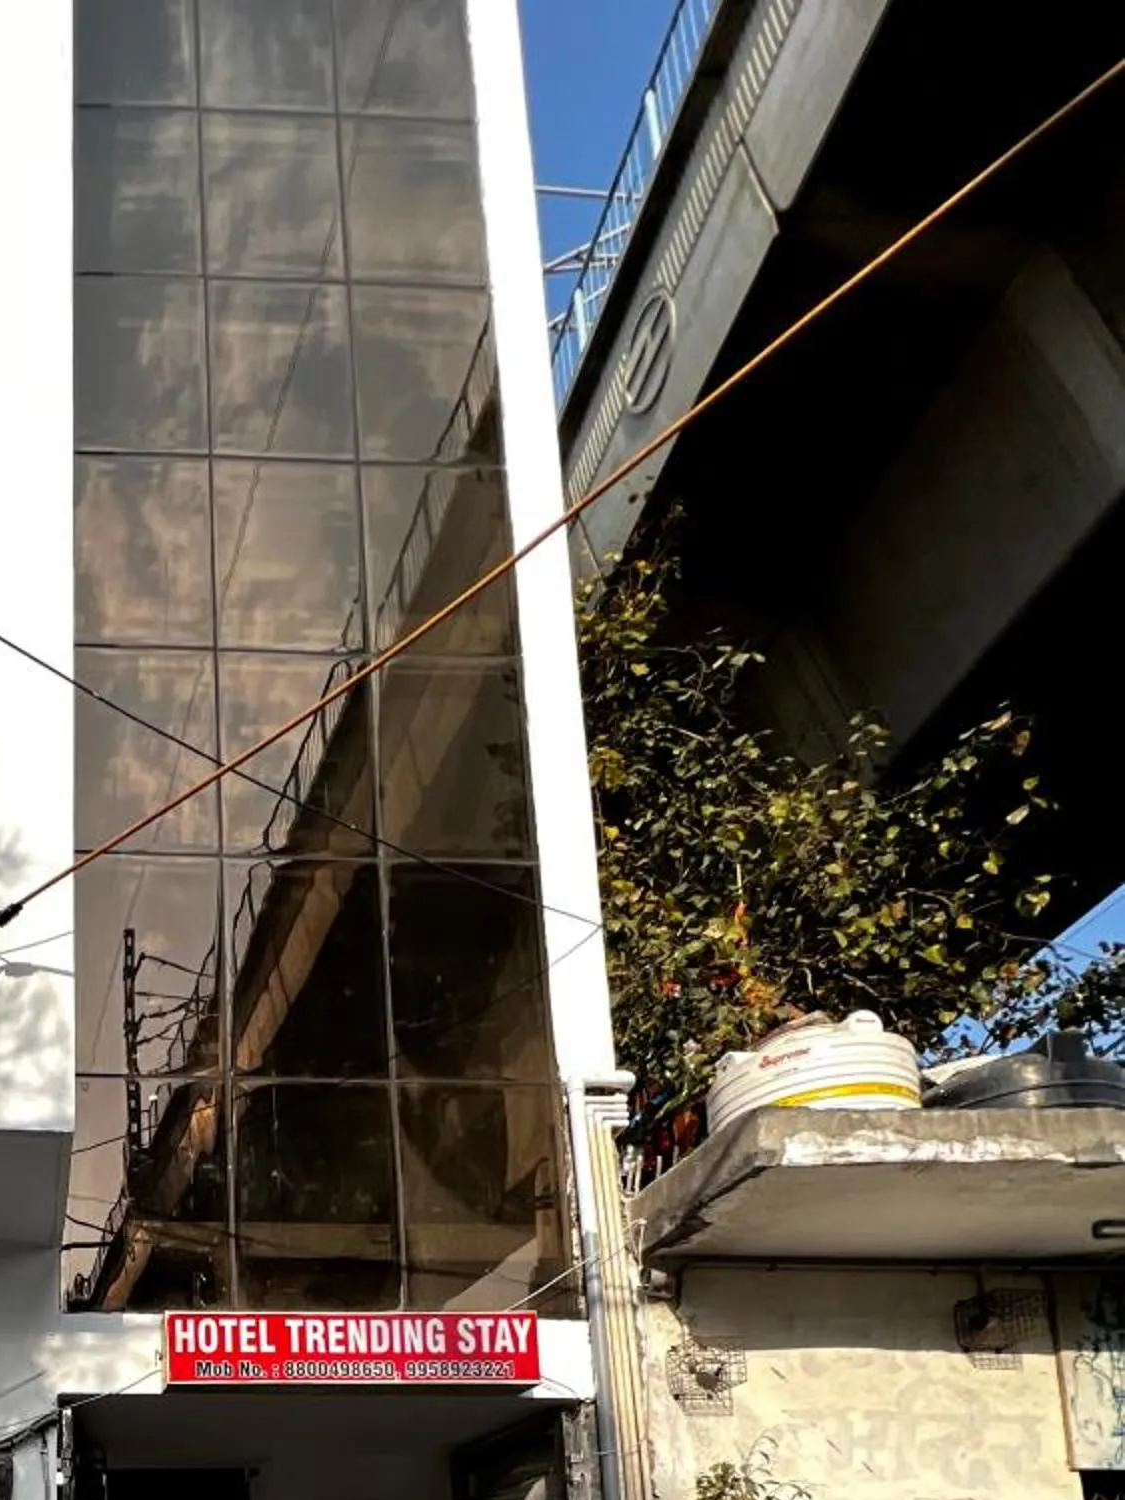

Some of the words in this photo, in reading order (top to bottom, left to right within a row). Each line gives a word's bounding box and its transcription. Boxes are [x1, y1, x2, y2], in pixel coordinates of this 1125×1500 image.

[175, 1318, 276, 1353] HOTEL
[285, 1318, 446, 1353] TRENDING
[457, 1318, 531, 1353] STAY
[196, 1360, 233, 1376] Mob
[240, 1361, 266, 1376] No.
[407, 1360, 513, 1377] 9958923221
